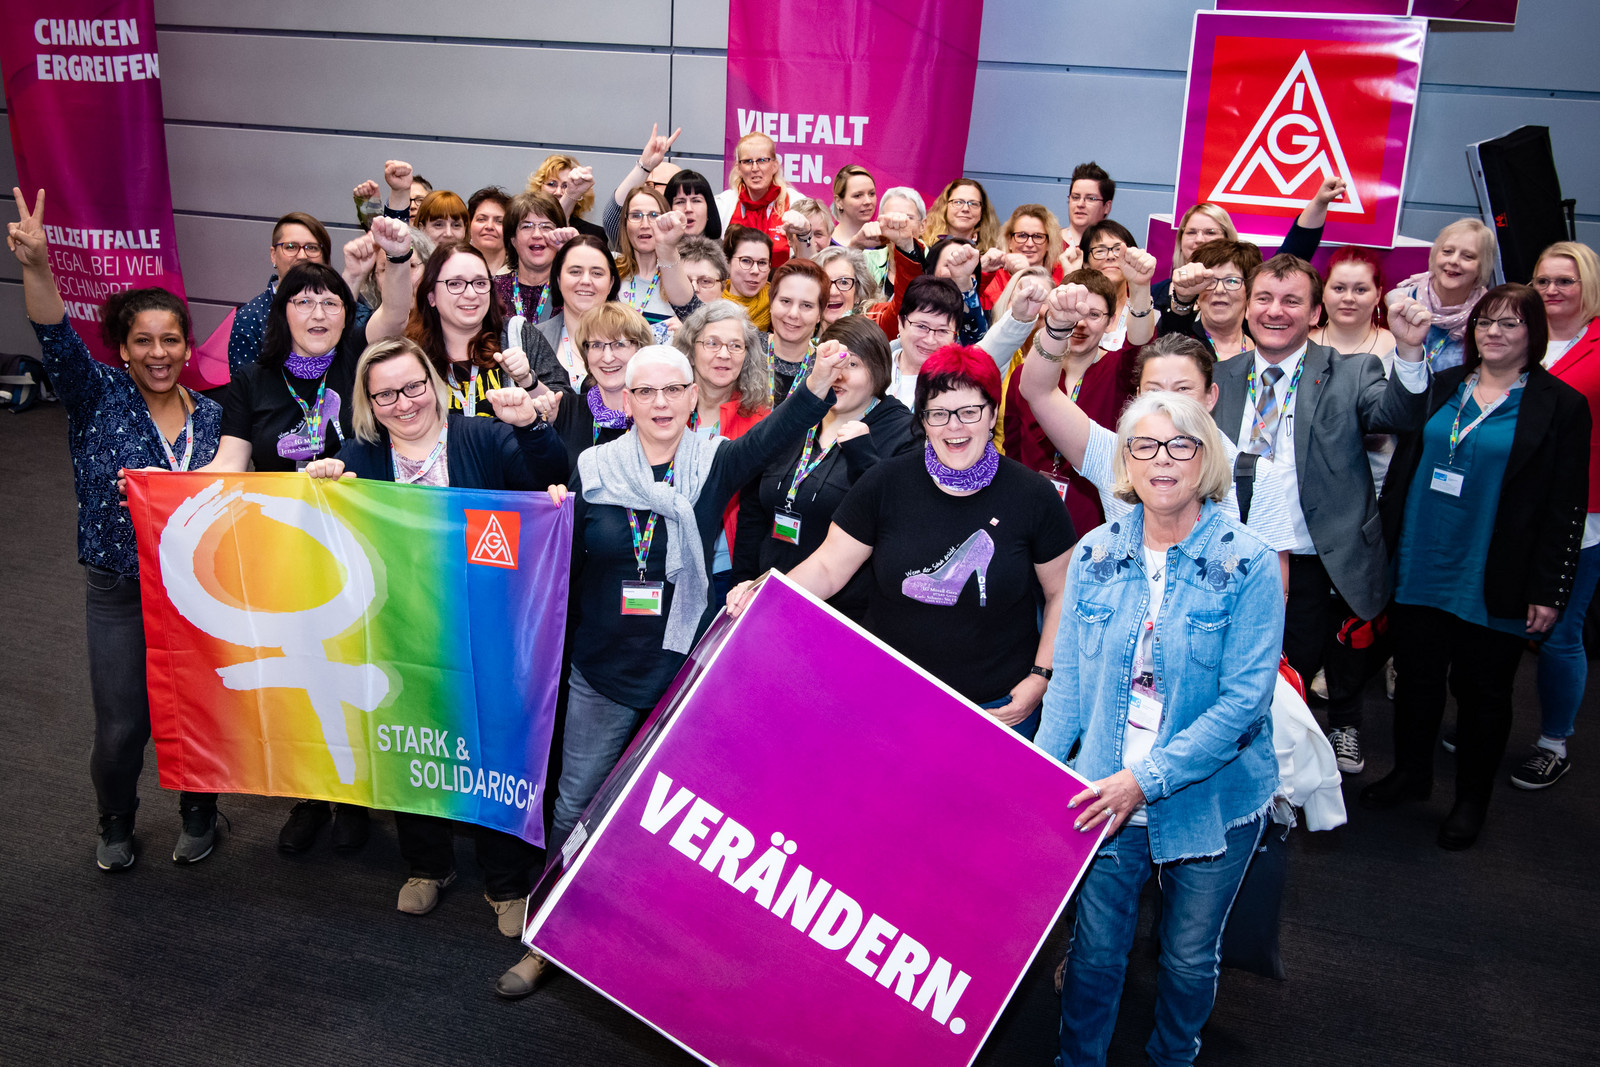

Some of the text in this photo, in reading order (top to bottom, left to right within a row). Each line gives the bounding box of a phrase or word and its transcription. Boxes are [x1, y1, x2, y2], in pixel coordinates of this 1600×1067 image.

[34, 18, 140, 46] CHANCEN
[36, 53, 160, 82] ERGREIFEN
[737, 108, 869, 146] VIELFALT
[42, 224, 161, 250] EILZEITFALLE
[54, 250, 91, 276] EGAL,
[91, 255, 120, 276] BEI
[978, 576, 987, 599] OFA
[377, 724, 470, 761] STARK &
[410, 759, 538, 813] SOLIDARISCH
[639, 770, 972, 1035] VERÄNDERN.
